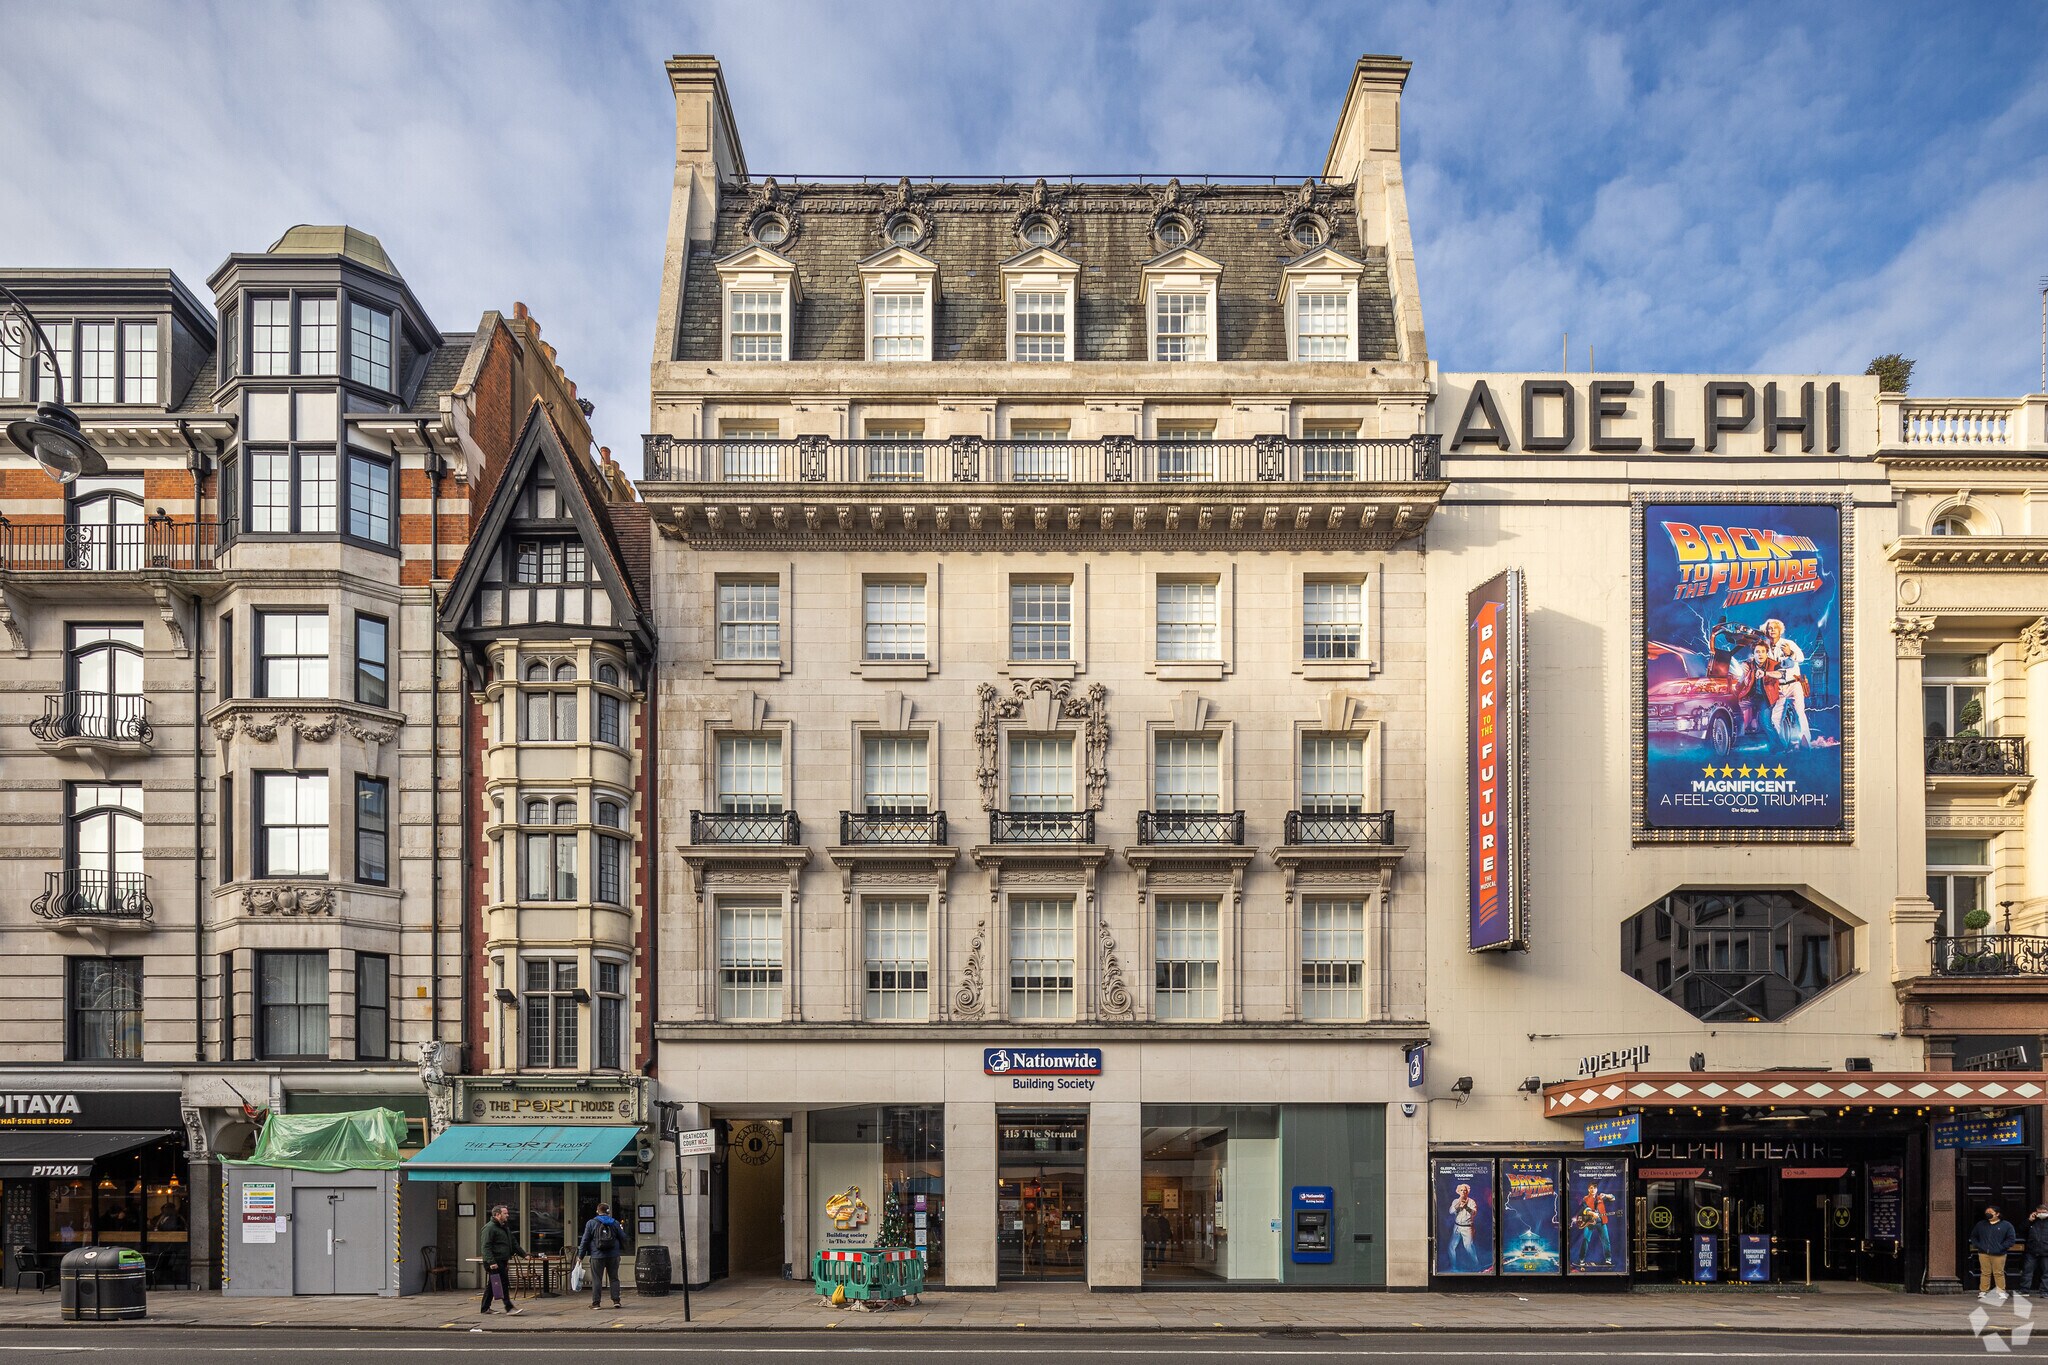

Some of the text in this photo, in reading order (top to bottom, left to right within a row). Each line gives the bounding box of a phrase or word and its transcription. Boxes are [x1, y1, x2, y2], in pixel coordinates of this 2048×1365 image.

[1449, 379, 1841, 453] ADELPHI
[1661, 521, 1797, 561] BACK
[1679, 562, 1709, 583] TO
[1708, 557, 1818, 595] FUTURE
[1674, 581, 1707, 600] THE
[1744, 579, 1816, 602] THE MUSICAL
[1480, 623, 1494, 710] BACK
[1483, 714, 1491, 725] TO
[1481, 725, 1493, 737] THE
[1660, 793, 1672, 806] A
[1674, 793, 1759, 806] FEEL-GOOD
[1481, 742, 1495, 873] FUTURE
[1484, 874, 1492, 882] THE
[1480, 880, 1497, 891] MUSICAL
[1013, 1053, 1097, 1068] Nationwide
[1577, 1044, 1649, 1075] ADELPHI
[1013, 1078, 1095, 1091] Building Society
[489, 1100, 511, 1112] THE
[512, 1098, 579, 1113] PORT
[580, 1100, 614, 1112] HOUSE
[682, 1131, 709, 1139] HEATHCOCK
[735, 1124, 776, 1147] HEATHCOCK
[1003, 1129, 1077, 1139] 415 The Strand
[464, 1141, 593, 1149] THE PORT HOUSE
[740, 1152, 771, 1165] COURT
[32, 1165, 79, 1176] PITAYA
[1506, 1173, 1546, 1186] BACK
[1701, 1244, 1711, 1252] BOX
[1698, 1251, 1713, 1260] OFFICE
